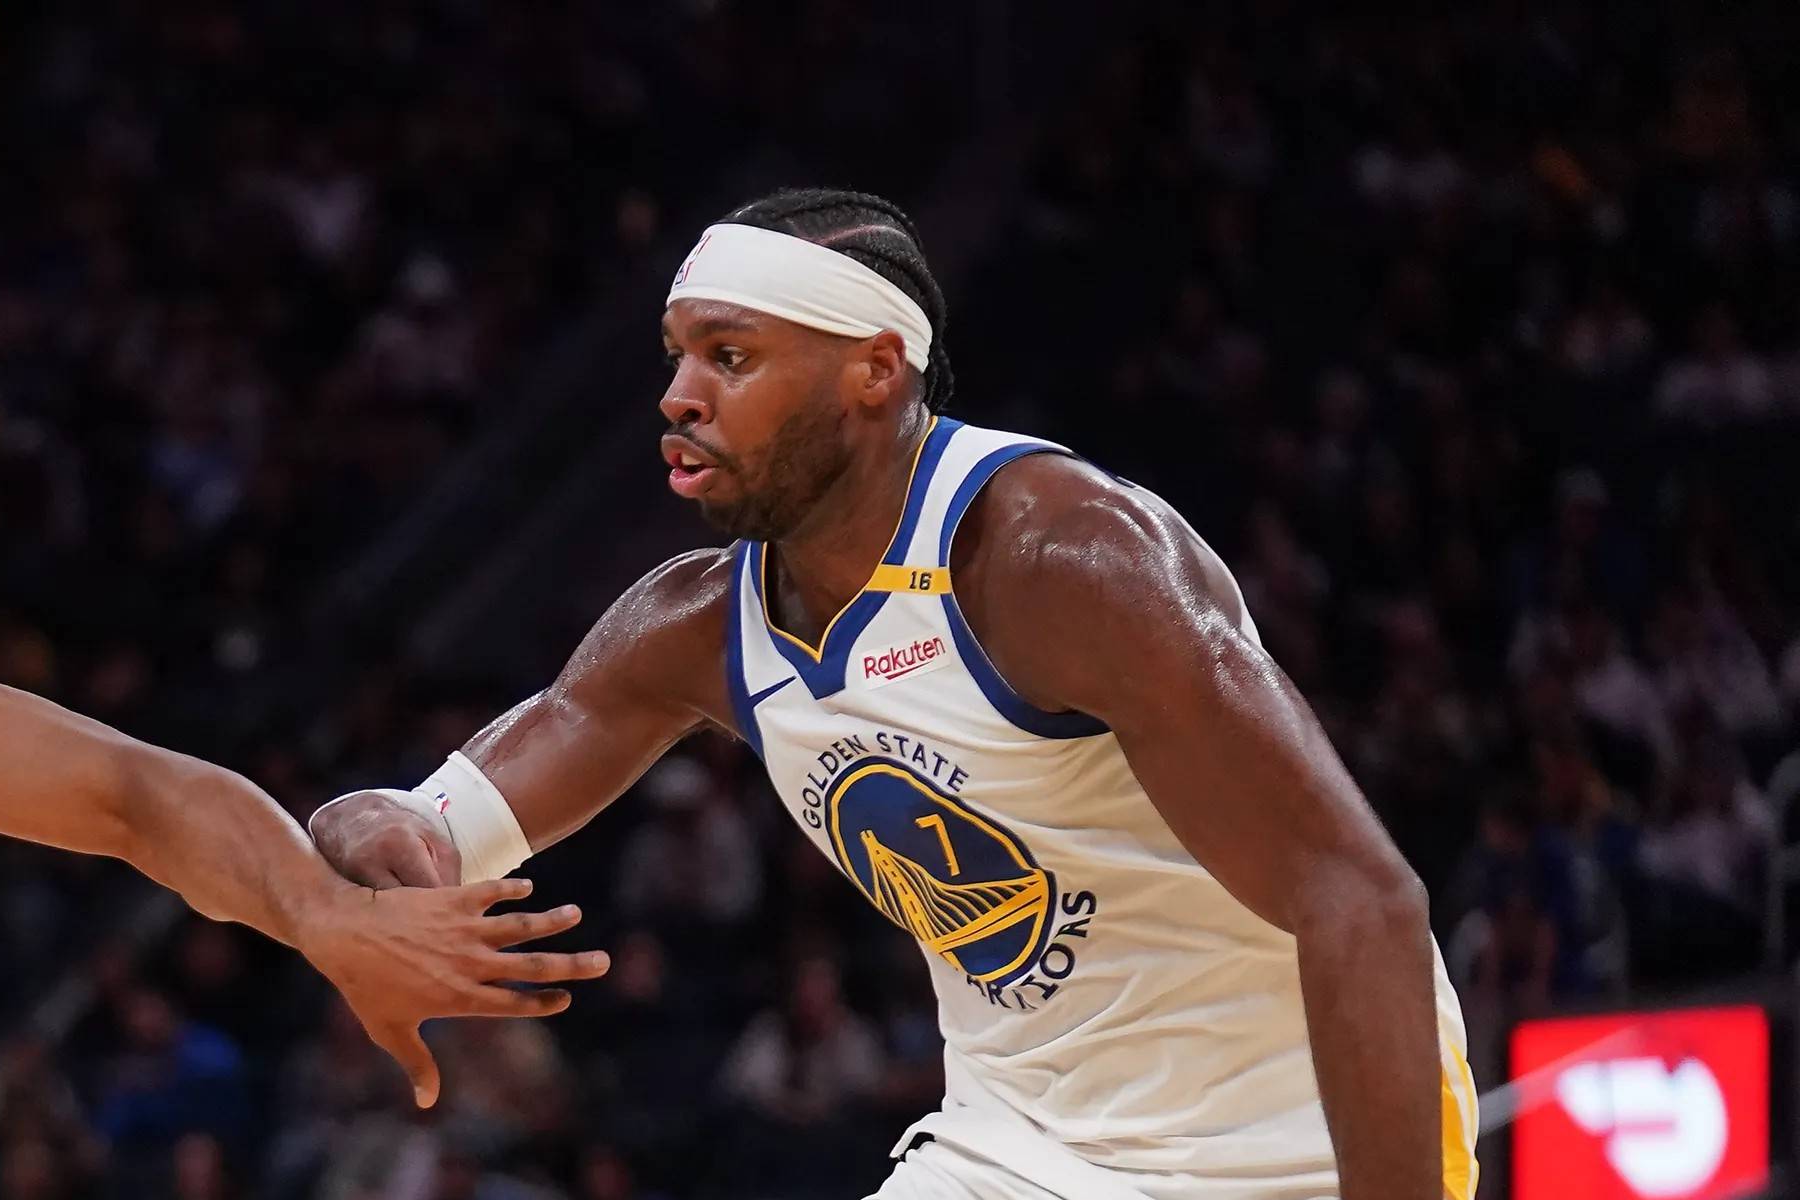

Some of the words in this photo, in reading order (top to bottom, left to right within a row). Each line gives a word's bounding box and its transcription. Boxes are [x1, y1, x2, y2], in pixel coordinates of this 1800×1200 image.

[909, 570, 932, 590] 16
[863, 637, 946, 679] Rakuten
[802, 734, 869, 829] GOLDEN
[876, 731, 970, 792] STATE
[915, 814, 960, 876] 7
